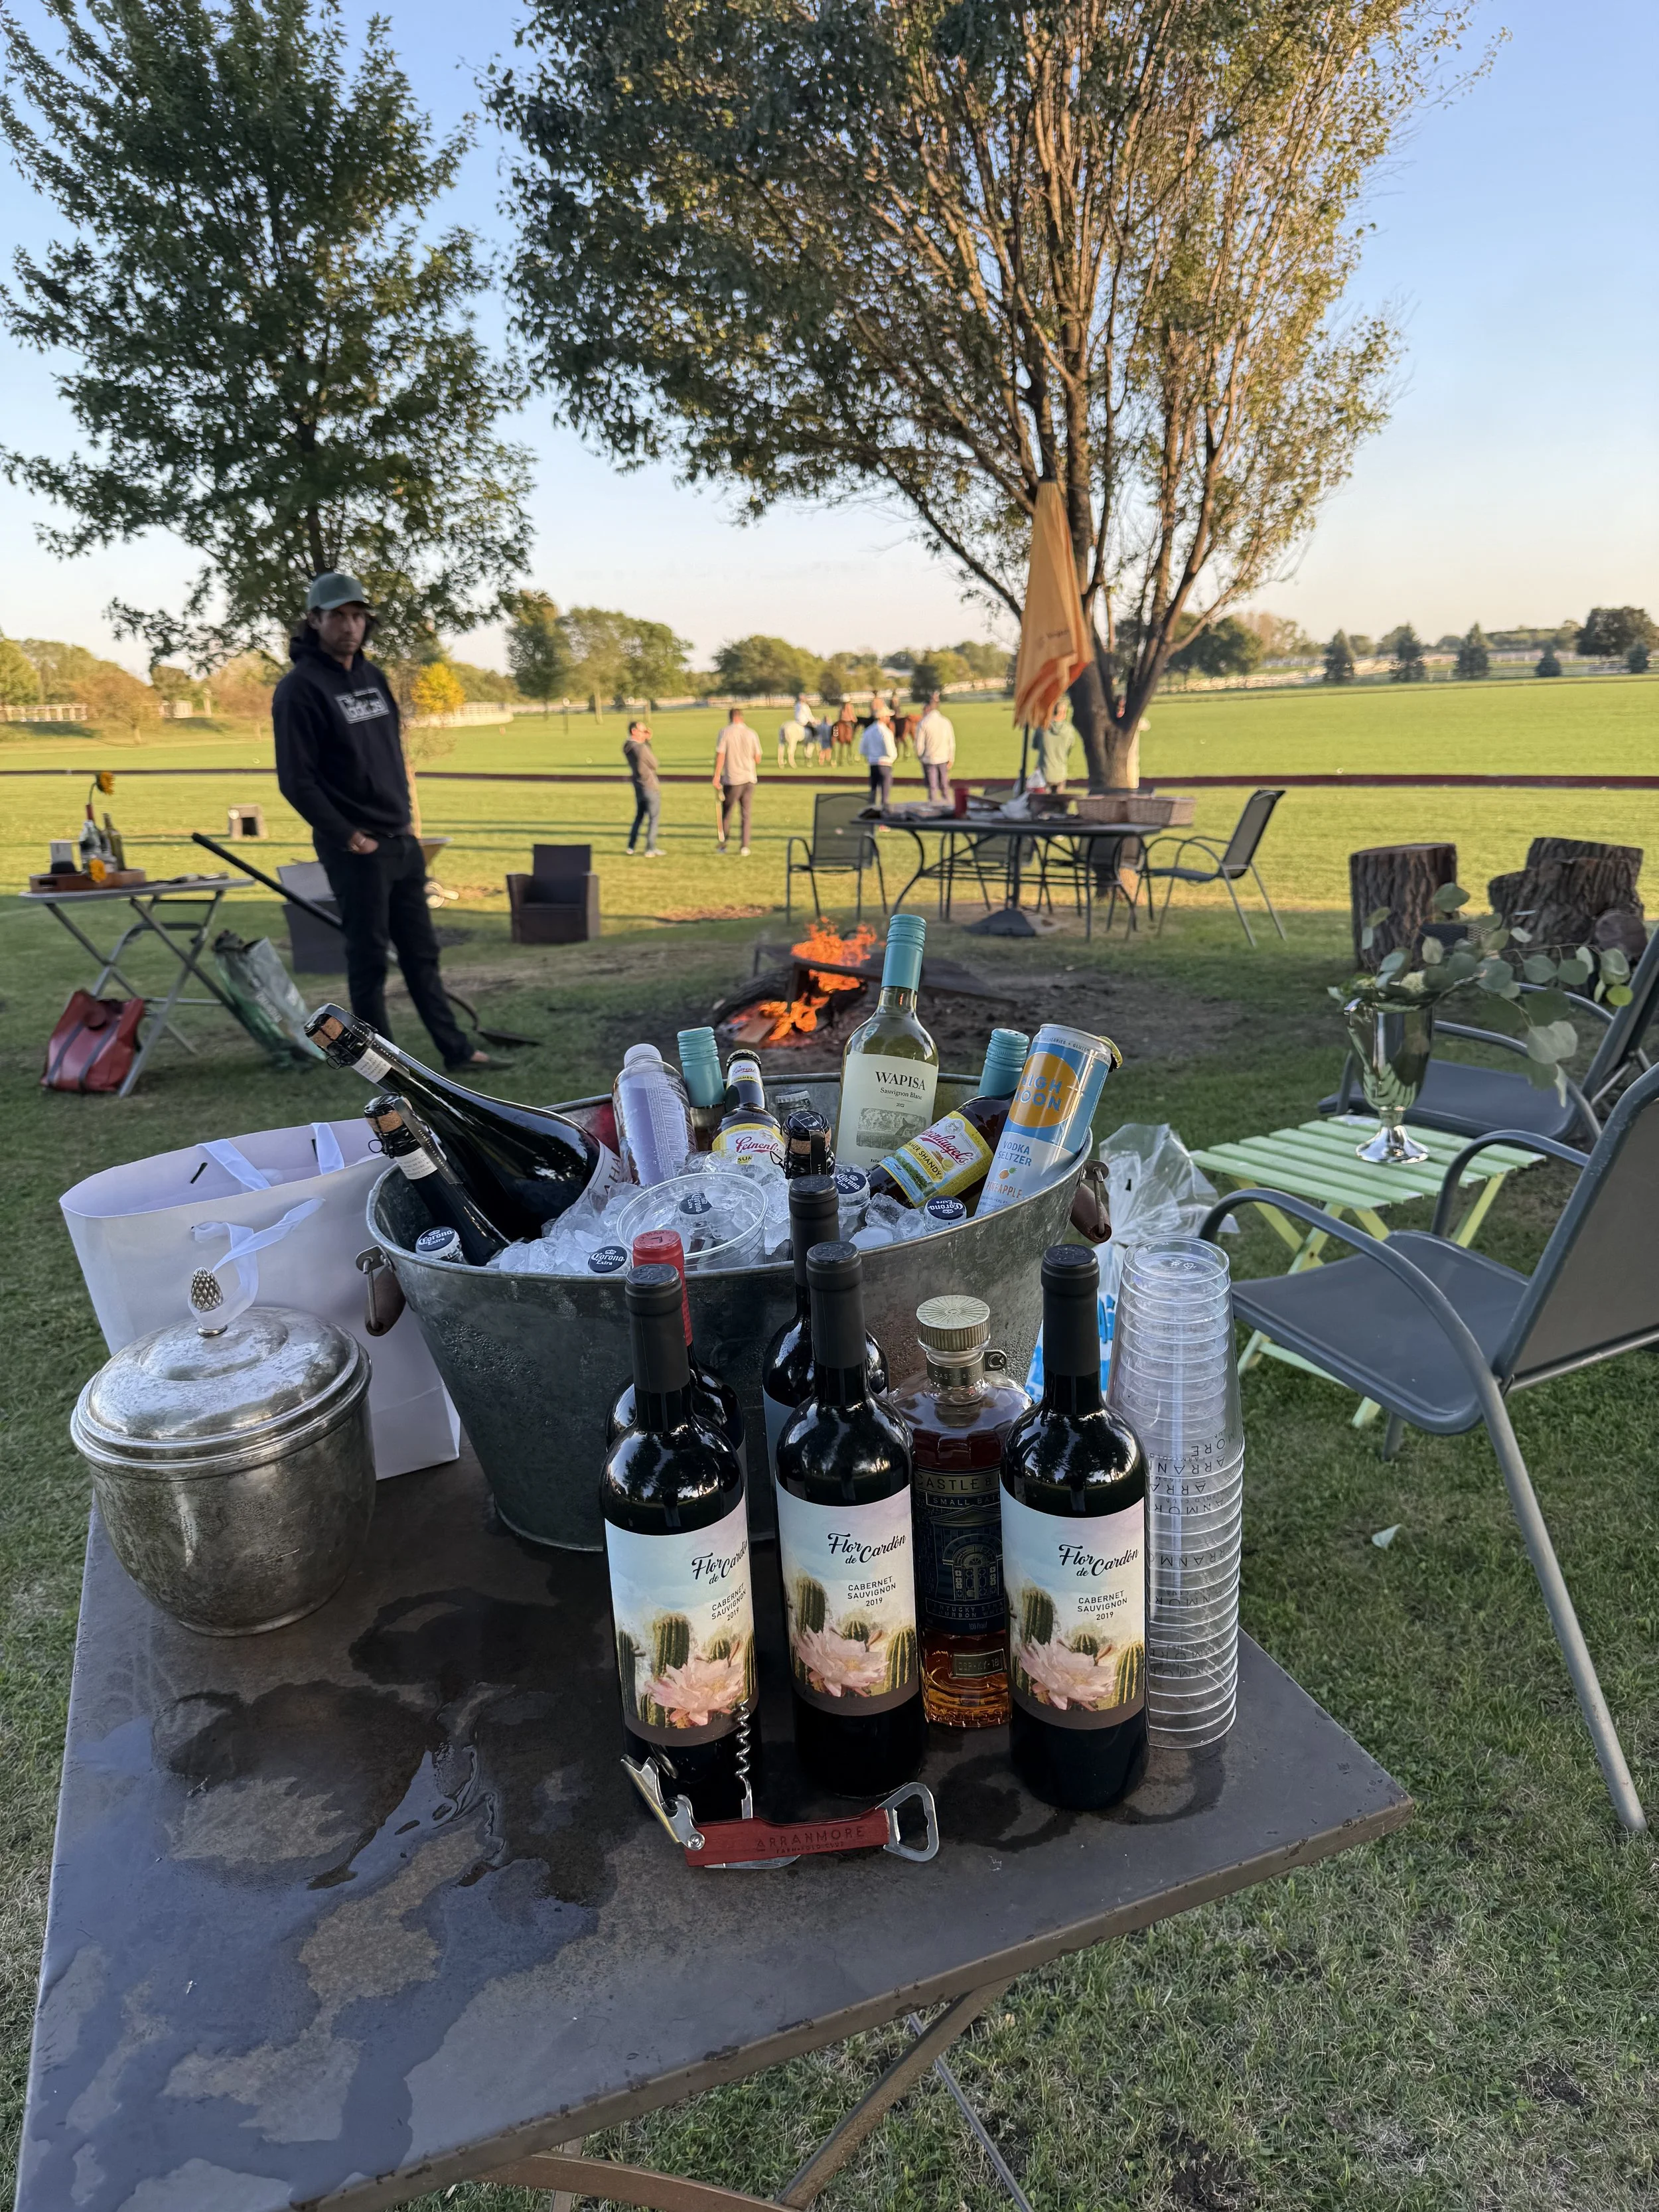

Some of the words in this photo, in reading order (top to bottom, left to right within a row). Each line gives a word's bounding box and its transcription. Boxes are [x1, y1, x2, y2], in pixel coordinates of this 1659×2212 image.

[875, 1071, 926, 1091] WAPISA
[1022, 1075, 1062, 1094] HIGH
[880, 1087, 909, 1098] Sauvignon
[910, 1091, 922, 1100] Blanc
[1003, 1141, 1031, 1155] VODKA
[918, 1150, 943, 1177] SHANDY
[997, 1151, 1032, 1167] SELTZER
[837, 1173, 861, 1191] Corona
[837, 1179, 849, 1189] Extra
[986, 1181, 1023, 1199] PINEAPPLE
[691, 1193, 702, 1213] Corona
[928, 1201, 964, 1211] Corona
[418, 1230, 455, 1246] Corona
[428, 1237, 445, 1246] Extra
[591, 1252, 626, 1262] Corona
[918, 1474, 980, 1491] CASTLE
[933, 1497, 970, 1506] SMALL
[828, 1533, 863, 1554] Flor
[859, 1535, 906, 1564] Cardón
[845, 1554, 857, 1564] de
[1058, 1544, 1095, 1566] Flor
[1091, 1549, 1139, 1577] Cardón
[691, 1552, 723, 1580] Flor
[709, 1573, 719, 1585] de
[1076, 1568, 1089, 1577] de
[847, 1582, 897, 1599] SAUVIGNON
[848, 1576, 893, 1591] CABERNET
[711, 1582, 745, 1611] CABERNET
[711, 1589, 747, 1620] SAUVIGNON
[865, 1597, 883, 1607] 2019
[1078, 1590, 1125, 1604] CABERNET
[1077, 1597, 1127, 1613] SAUVIGNON
[727, 1607, 739, 1621] 2019
[1096, 1611, 1114, 1621] 2019
[755, 1825, 865, 1852] ARRANMORE
